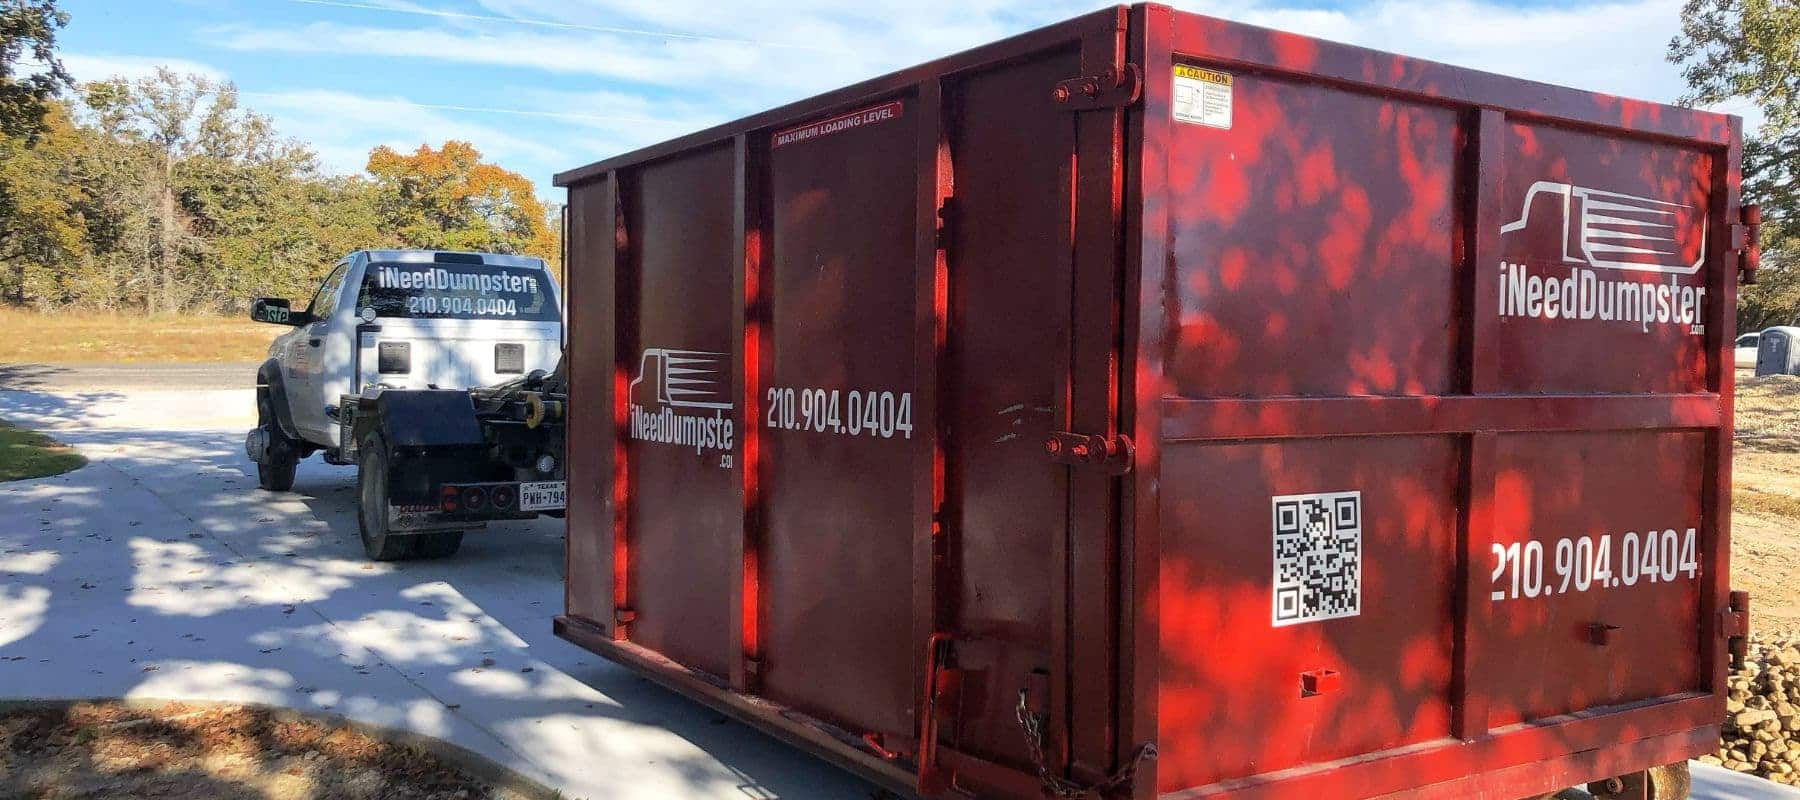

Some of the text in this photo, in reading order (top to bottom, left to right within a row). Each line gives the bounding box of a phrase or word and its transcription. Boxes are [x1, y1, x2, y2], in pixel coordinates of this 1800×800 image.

[1187, 68, 1228, 84] CAUTION
[777, 108, 894, 145] MAXIMUM LOADING LEVEL
[378, 266, 530, 295] iNeedDumpster
[1499, 261, 1706, 333] iNeedDumpster
[409, 296, 518, 316] 210.904.0404
[631, 404, 733, 455] iNeedDumpste
[766, 387, 913, 440] 210.904.0404
[1491, 528, 1698, 601] 210.904.0404
